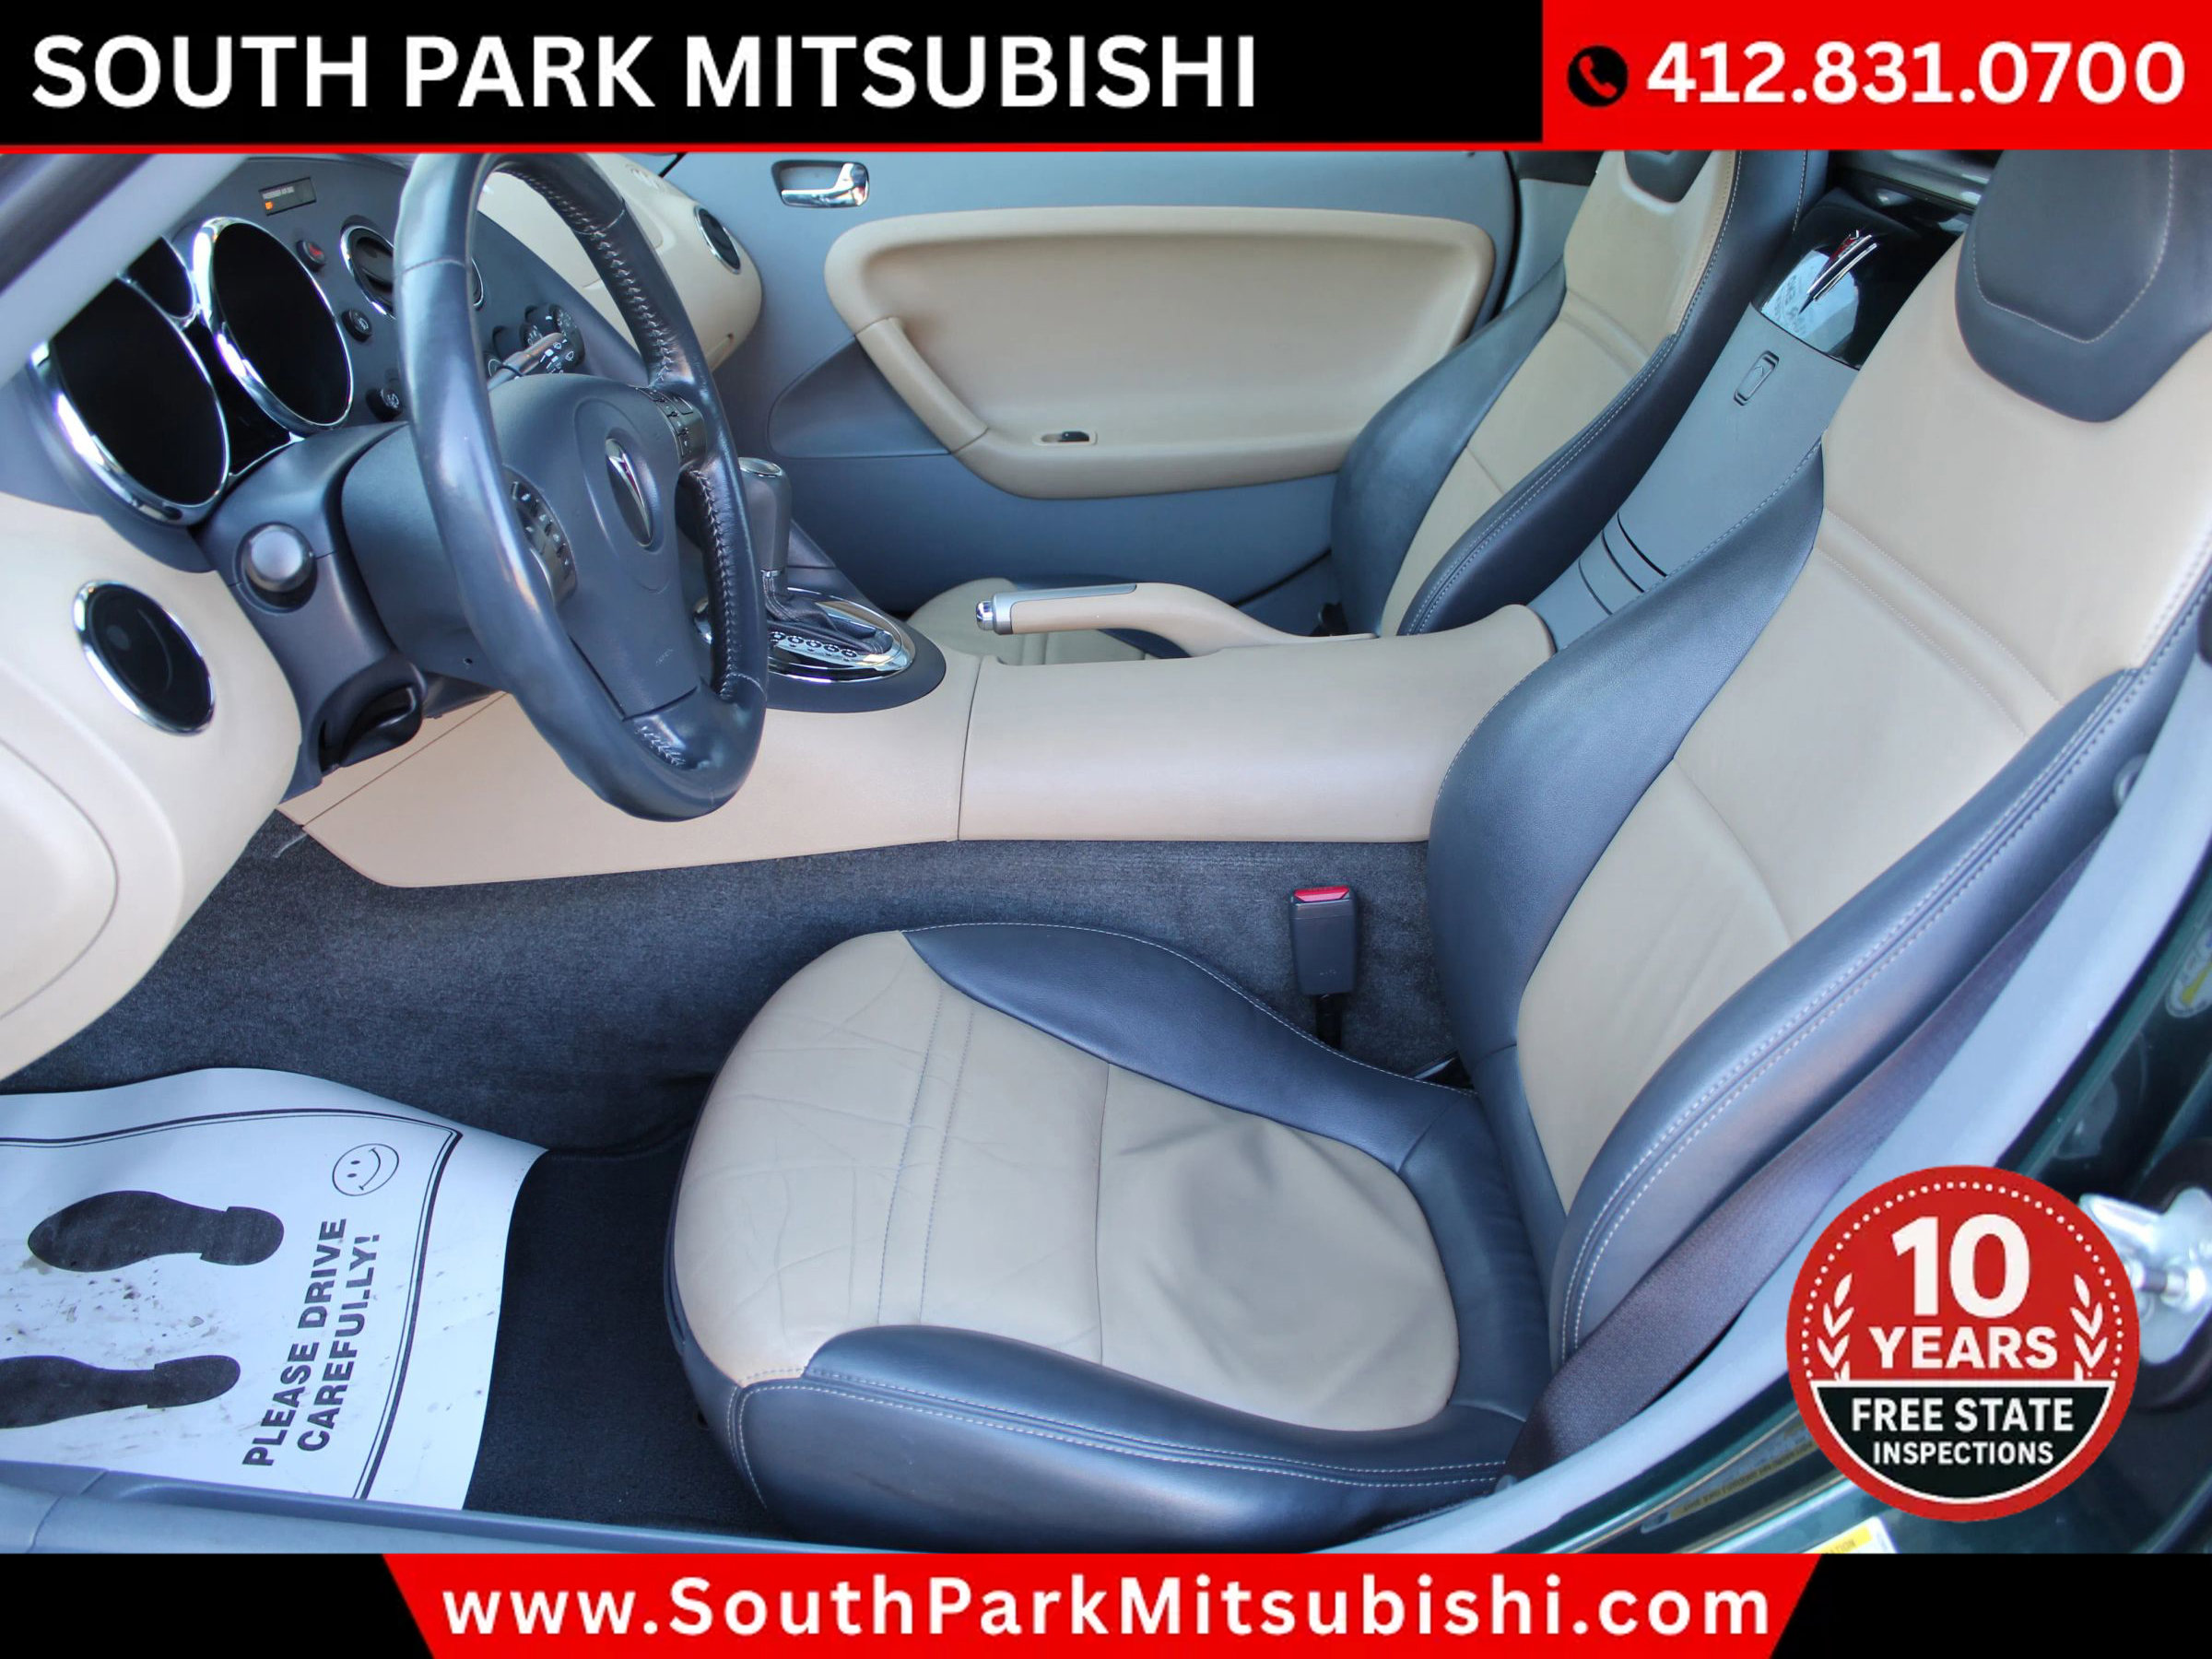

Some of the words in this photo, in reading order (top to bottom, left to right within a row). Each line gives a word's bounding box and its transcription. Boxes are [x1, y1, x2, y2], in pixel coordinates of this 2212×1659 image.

[242, 1342, 320, 1466] PLEASE
[298, 1218, 347, 1329] DRIVE
[297, 1234, 380, 1452] CAREFULLY!
